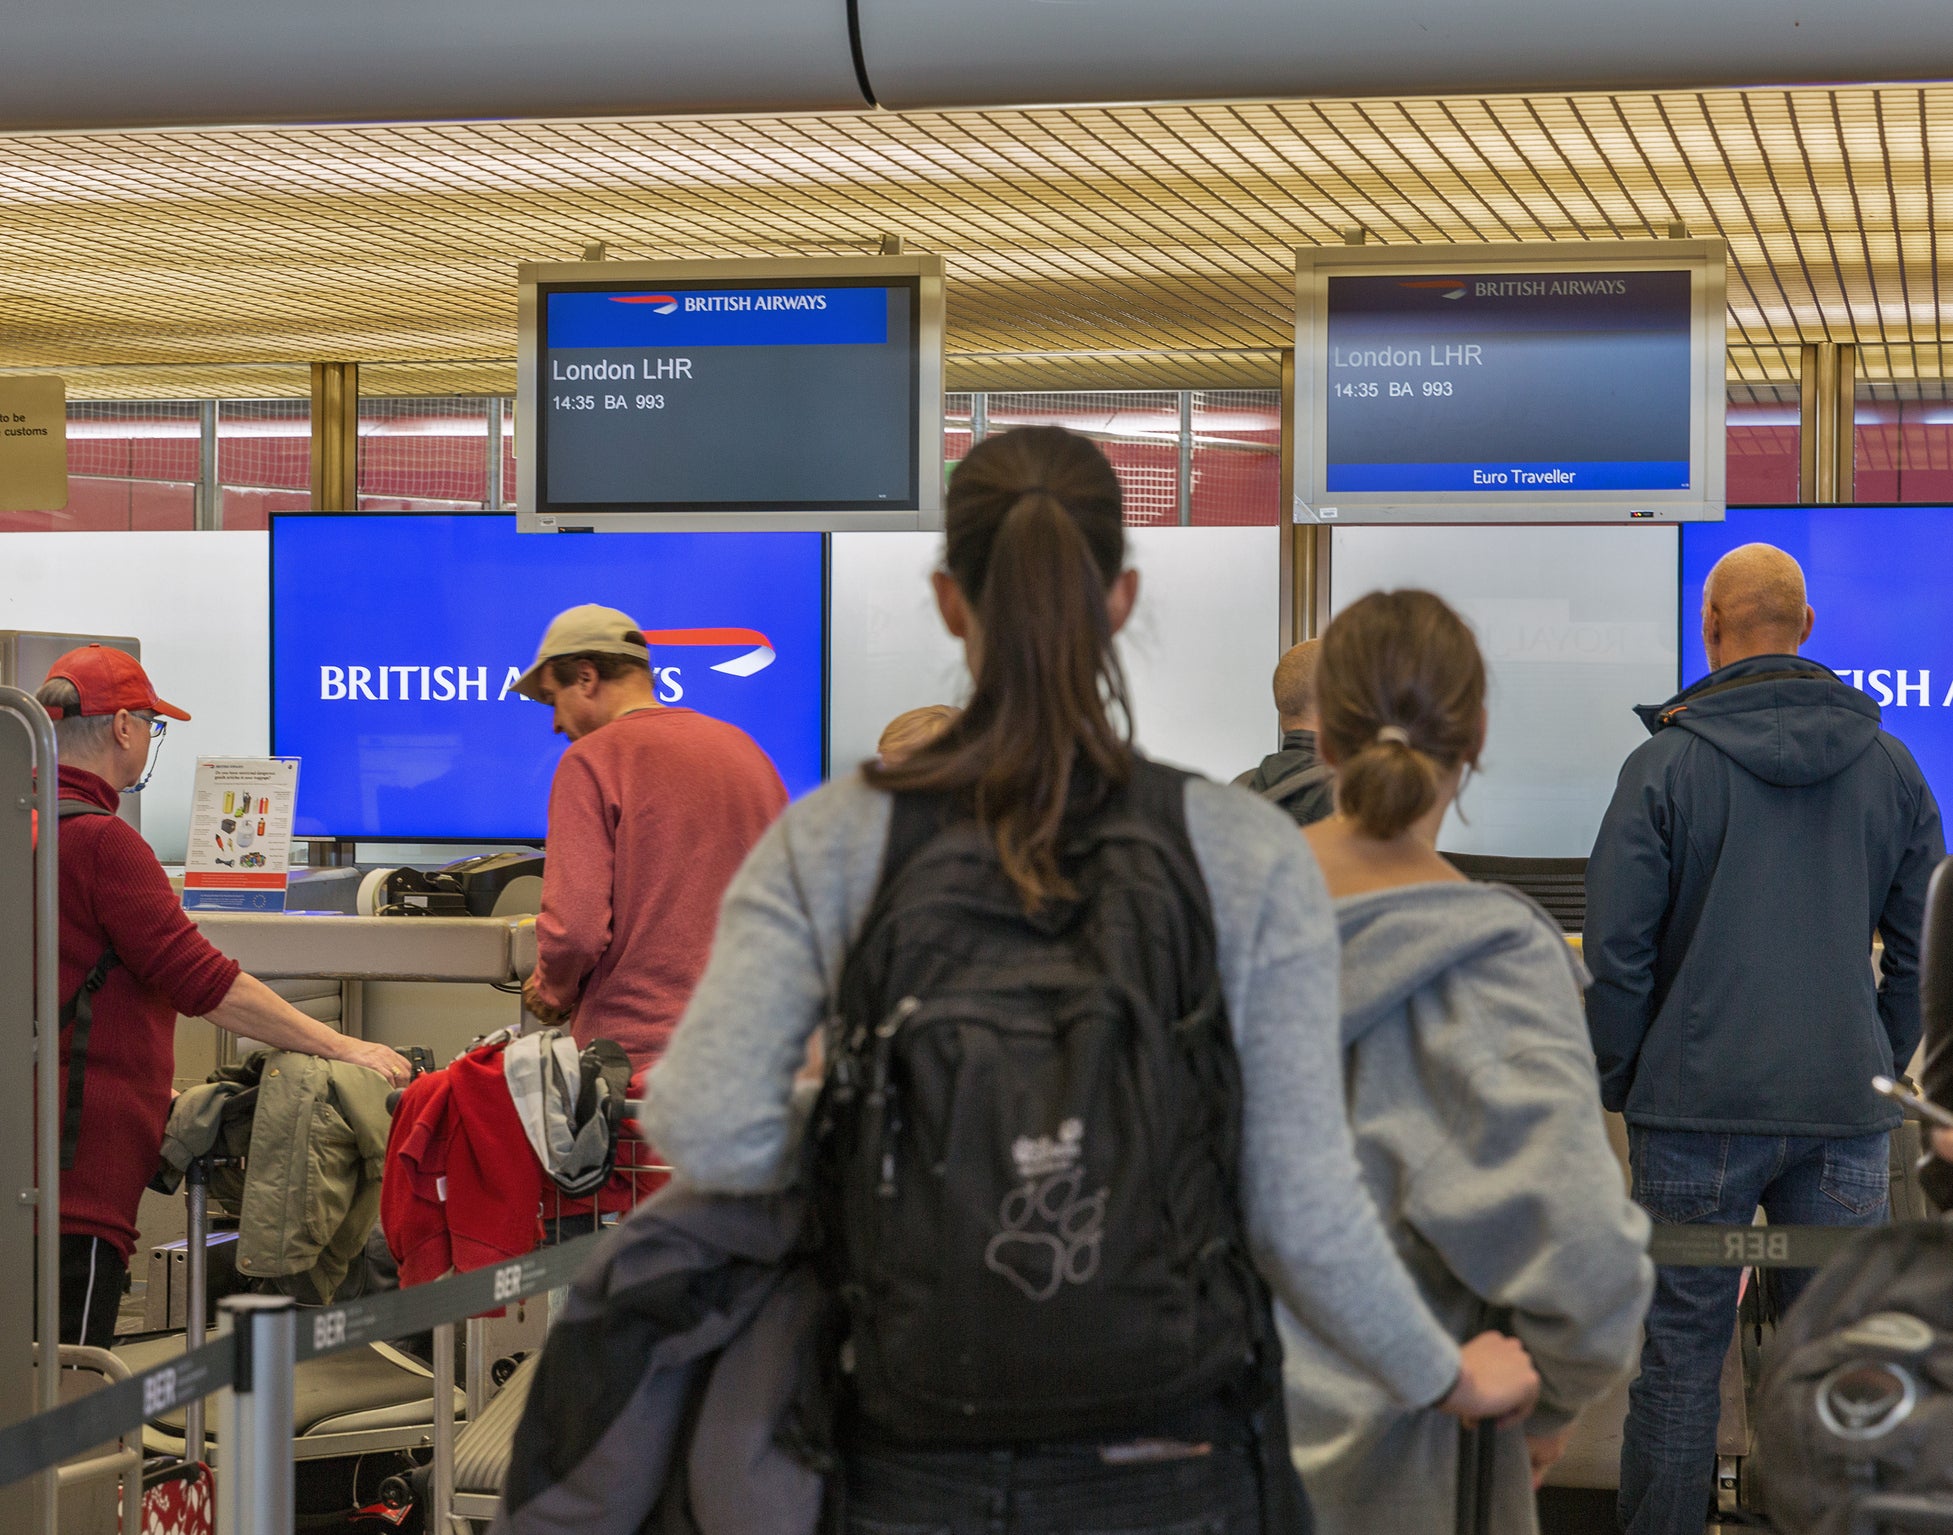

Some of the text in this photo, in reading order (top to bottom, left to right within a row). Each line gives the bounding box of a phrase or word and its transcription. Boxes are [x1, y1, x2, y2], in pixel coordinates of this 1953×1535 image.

[1475, 280, 1626, 297] BRITISH AIRWAYS
[684, 295, 827, 312] BRITISH AIRWAYS
[1334, 344, 1483, 368] London LHR
[553, 358, 693, 381] London LHR
[1334, 382, 1453, 398] 14:35 BA 993
[553, 394, 665, 410] 14:35 BA 993
[12, 413, 26, 423] be
[4, 427, 48, 437] customs
[1473, 468, 1577, 484] Euro Traveller
[320, 665, 488, 701] BRITISH
[494, 1264, 522, 1301] BER
[313, 1310, 347, 1351] BER
[143, 1366, 177, 1416] BER
